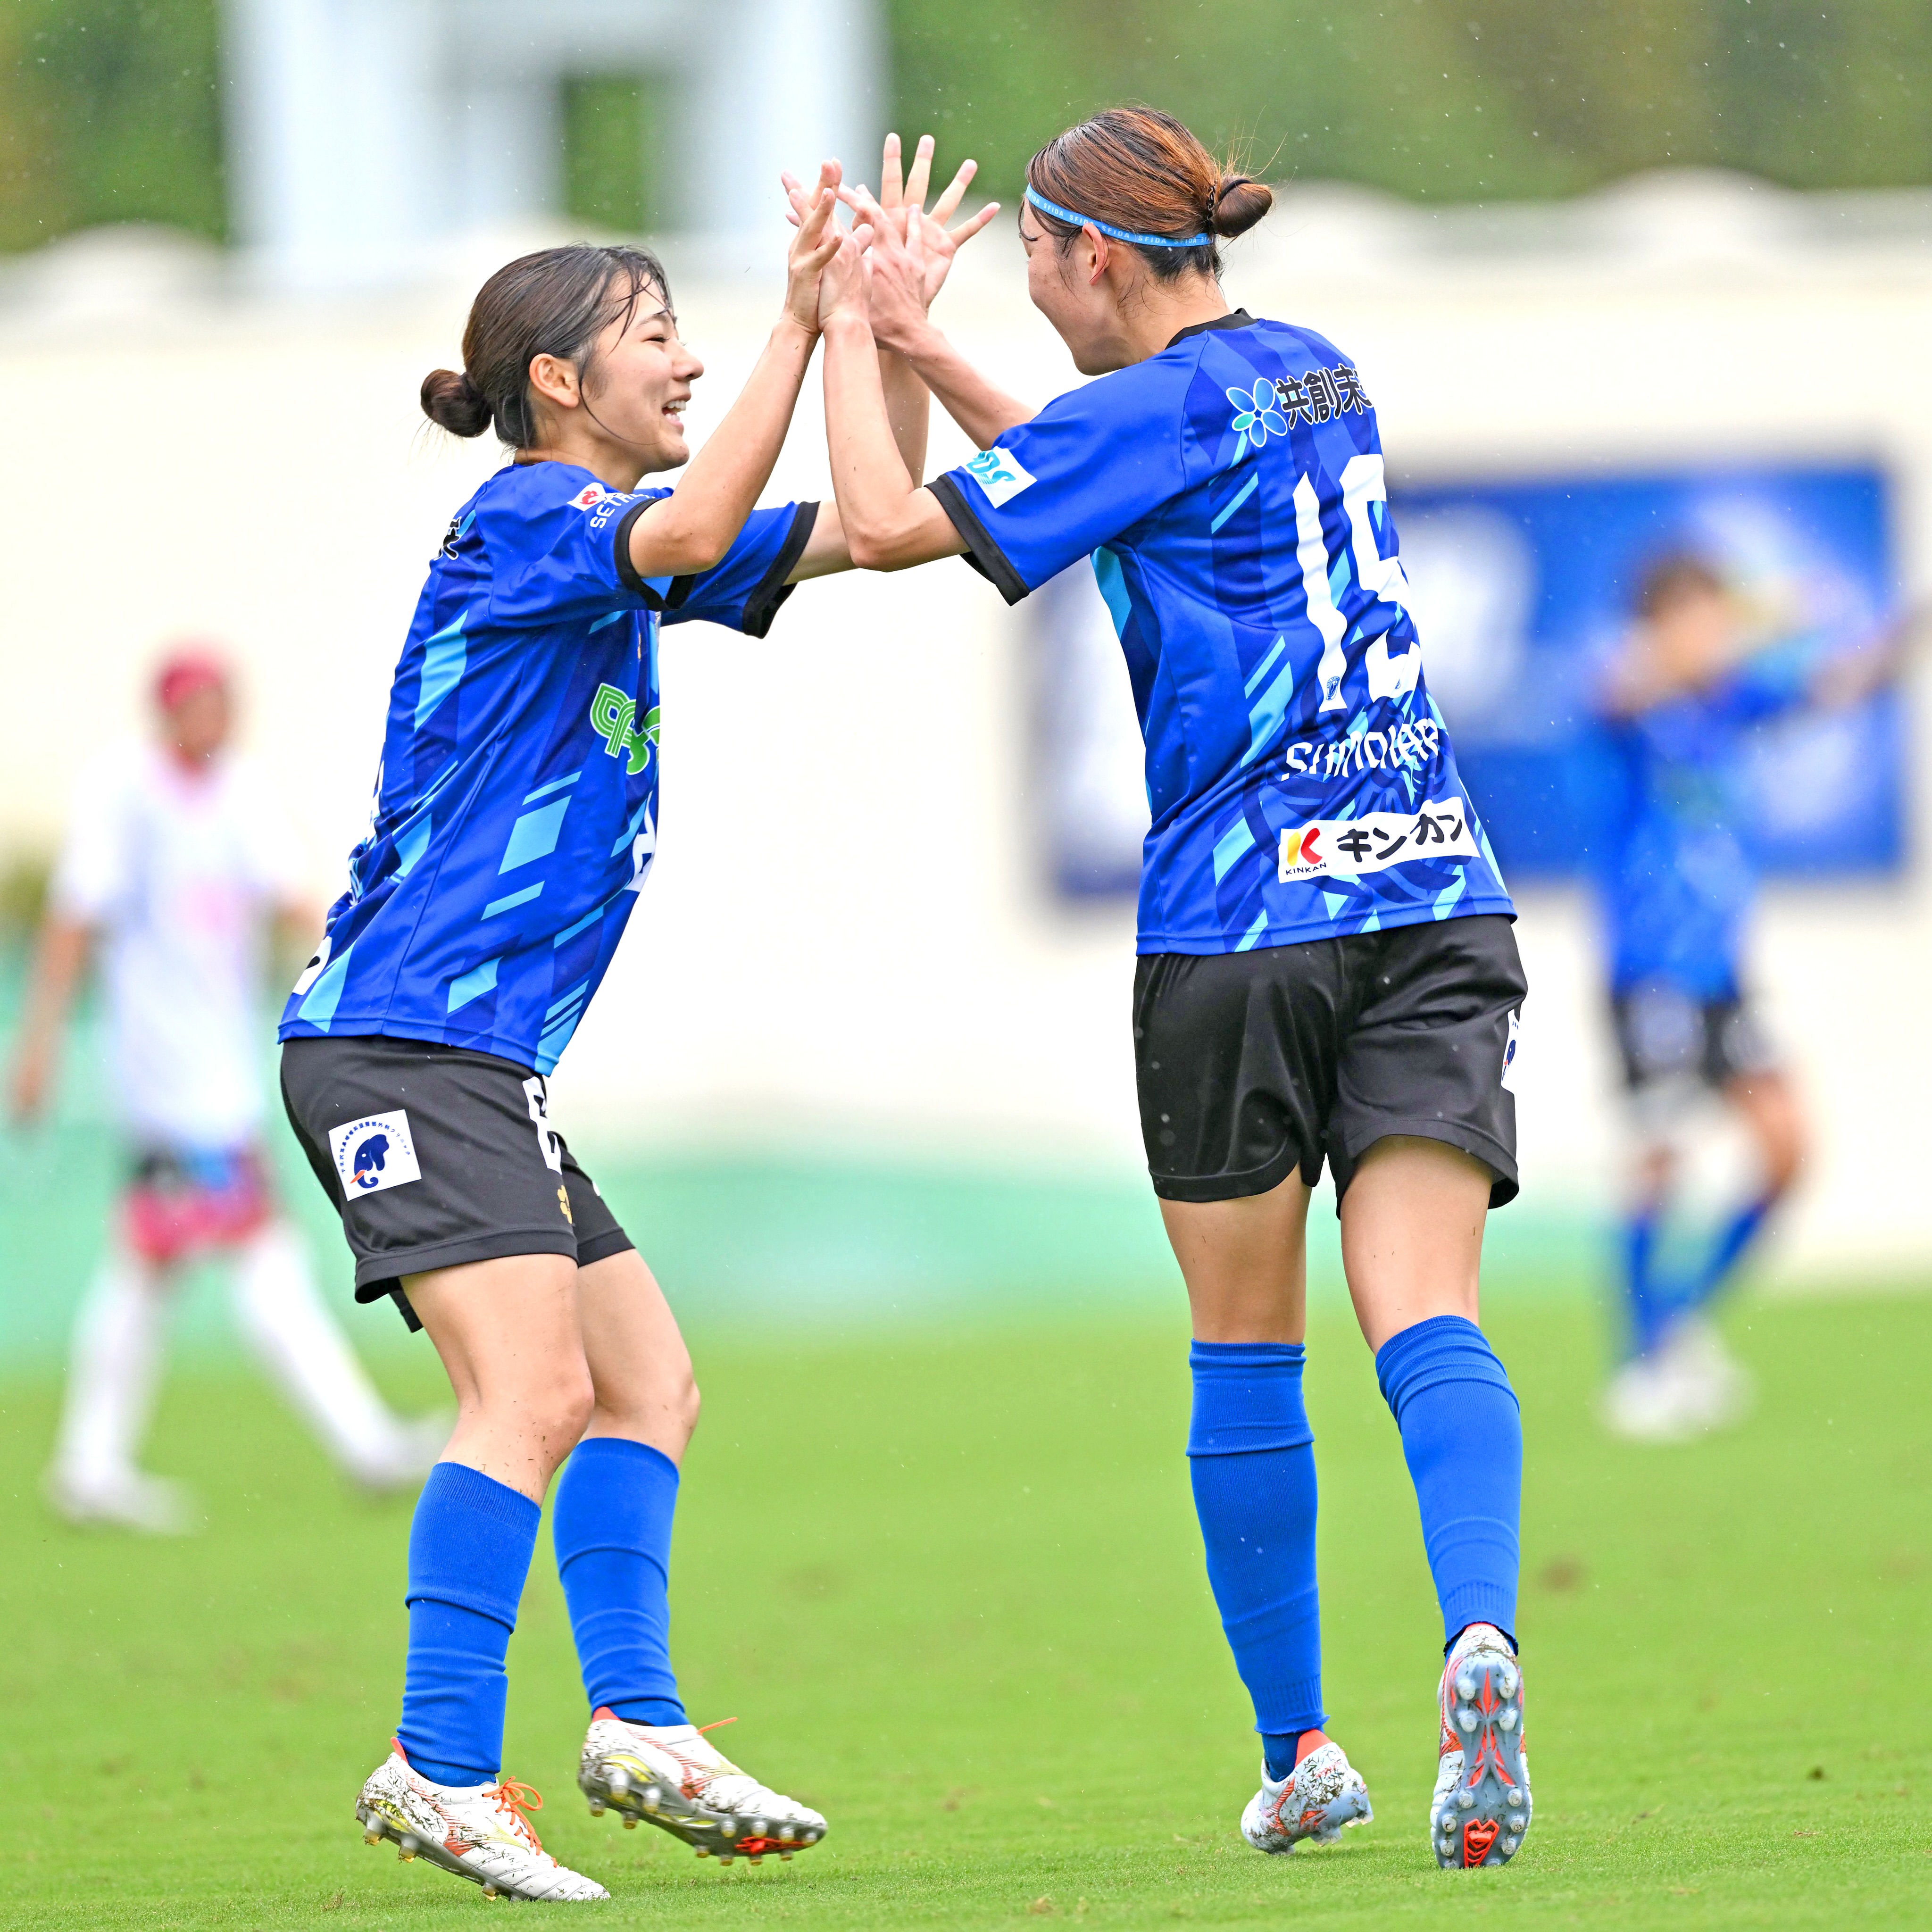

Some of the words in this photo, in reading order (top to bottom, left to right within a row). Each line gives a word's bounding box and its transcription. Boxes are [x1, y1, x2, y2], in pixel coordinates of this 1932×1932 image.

[1043, 203, 1063, 217] SFIDA
[1101, 225, 1130, 238] SFIDA
[1138, 235, 1166, 244] SFIDA
[1275, 363, 1374, 430] 共創未
[1336, 813, 1462, 863] キンカン
[1286, 862, 1327, 875] KINKAN
